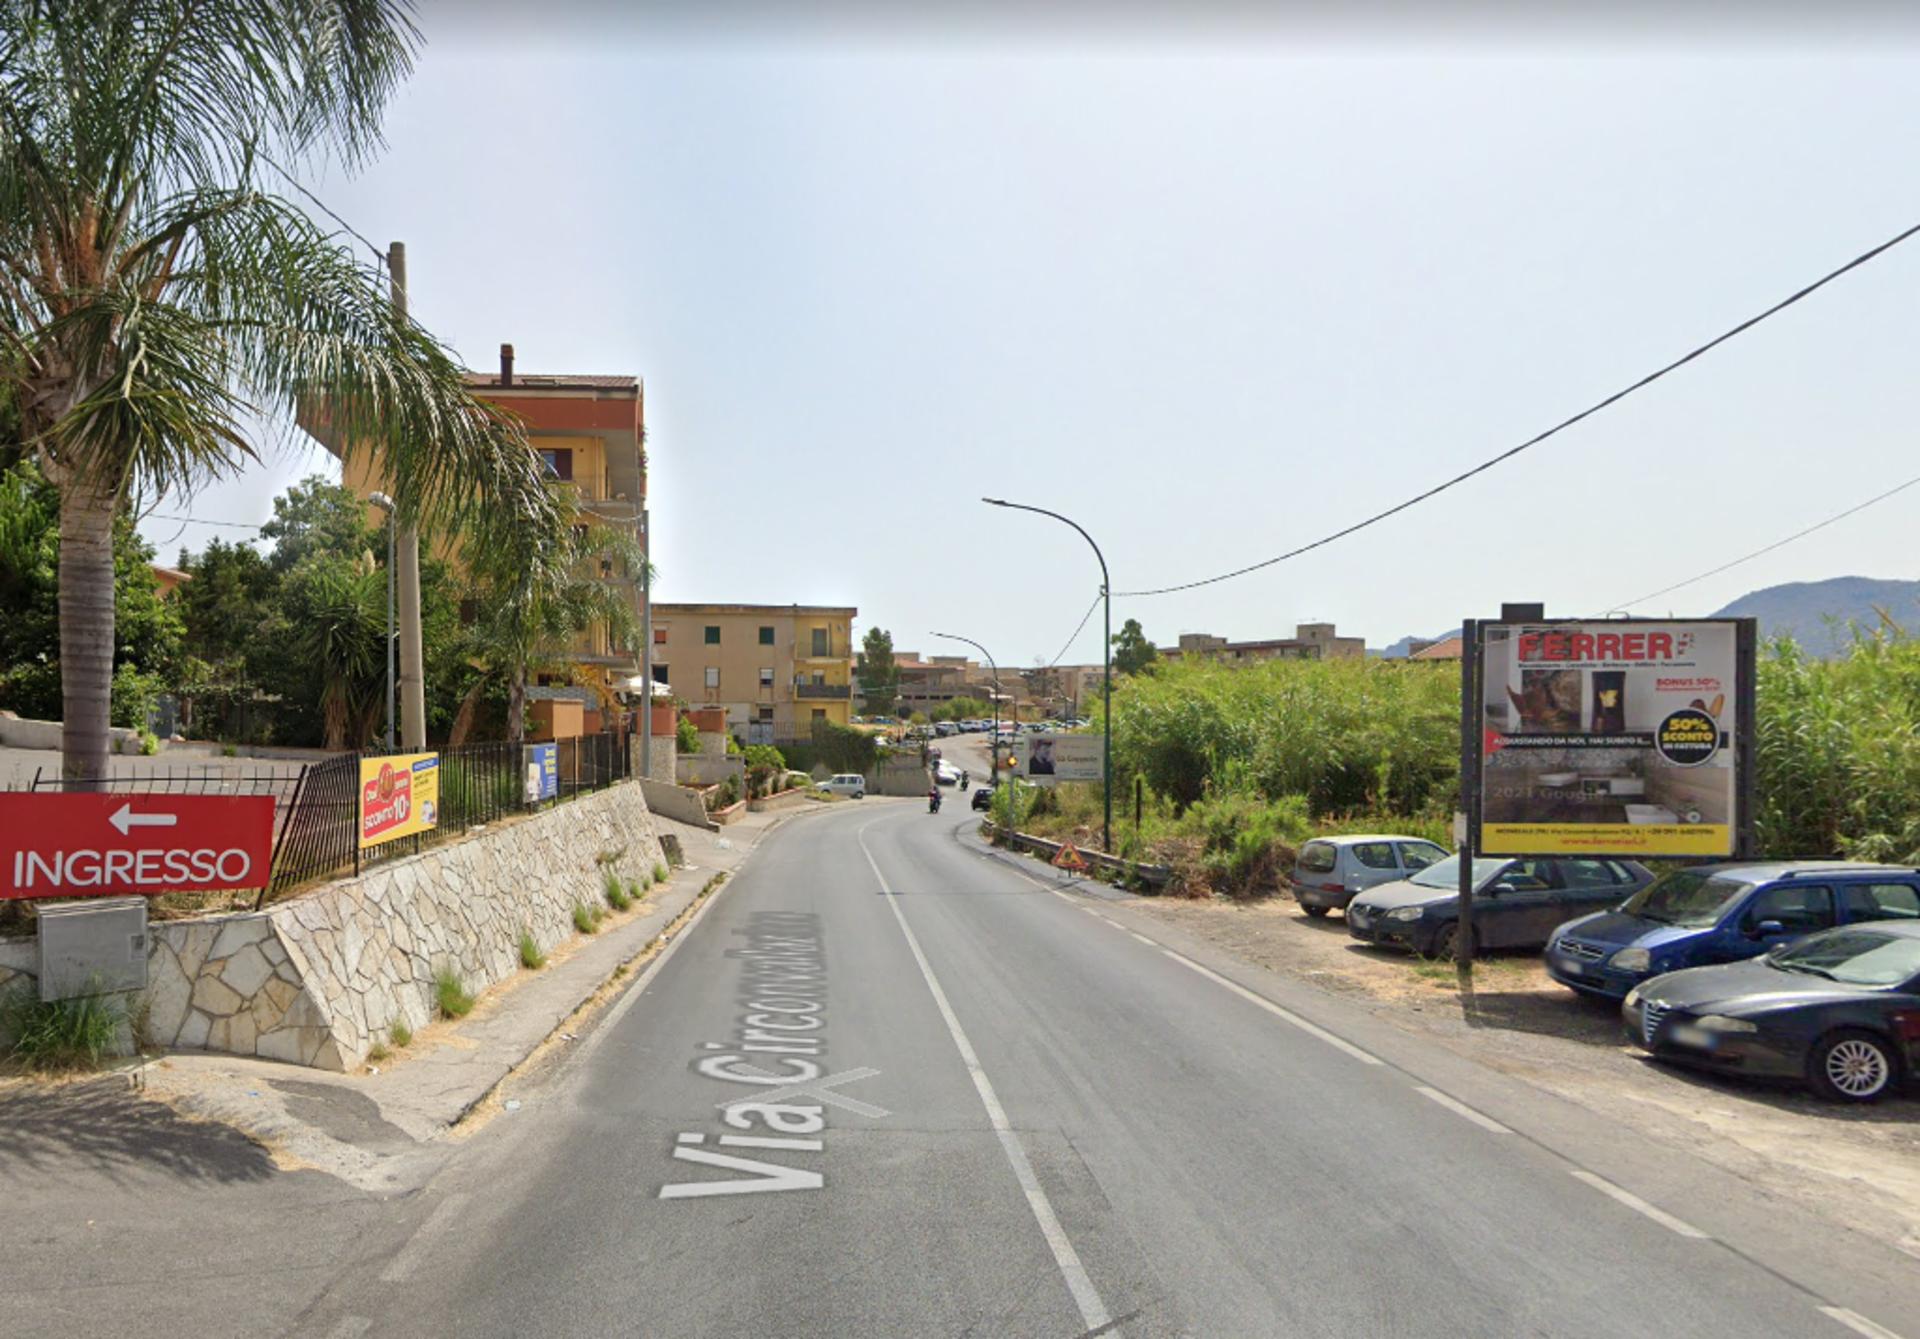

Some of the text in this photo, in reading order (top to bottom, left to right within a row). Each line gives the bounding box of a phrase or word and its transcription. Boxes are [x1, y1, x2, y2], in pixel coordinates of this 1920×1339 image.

[1518, 632, 1673, 661] FERRER
[1656, 678, 1693, 687] BONUS
[1669, 718, 1709, 731] 50%
[1554, 737, 1566, 745] DA
[1662, 731, 1714, 742] SCONTO
[14, 848, 251, 888] INGRESSO
